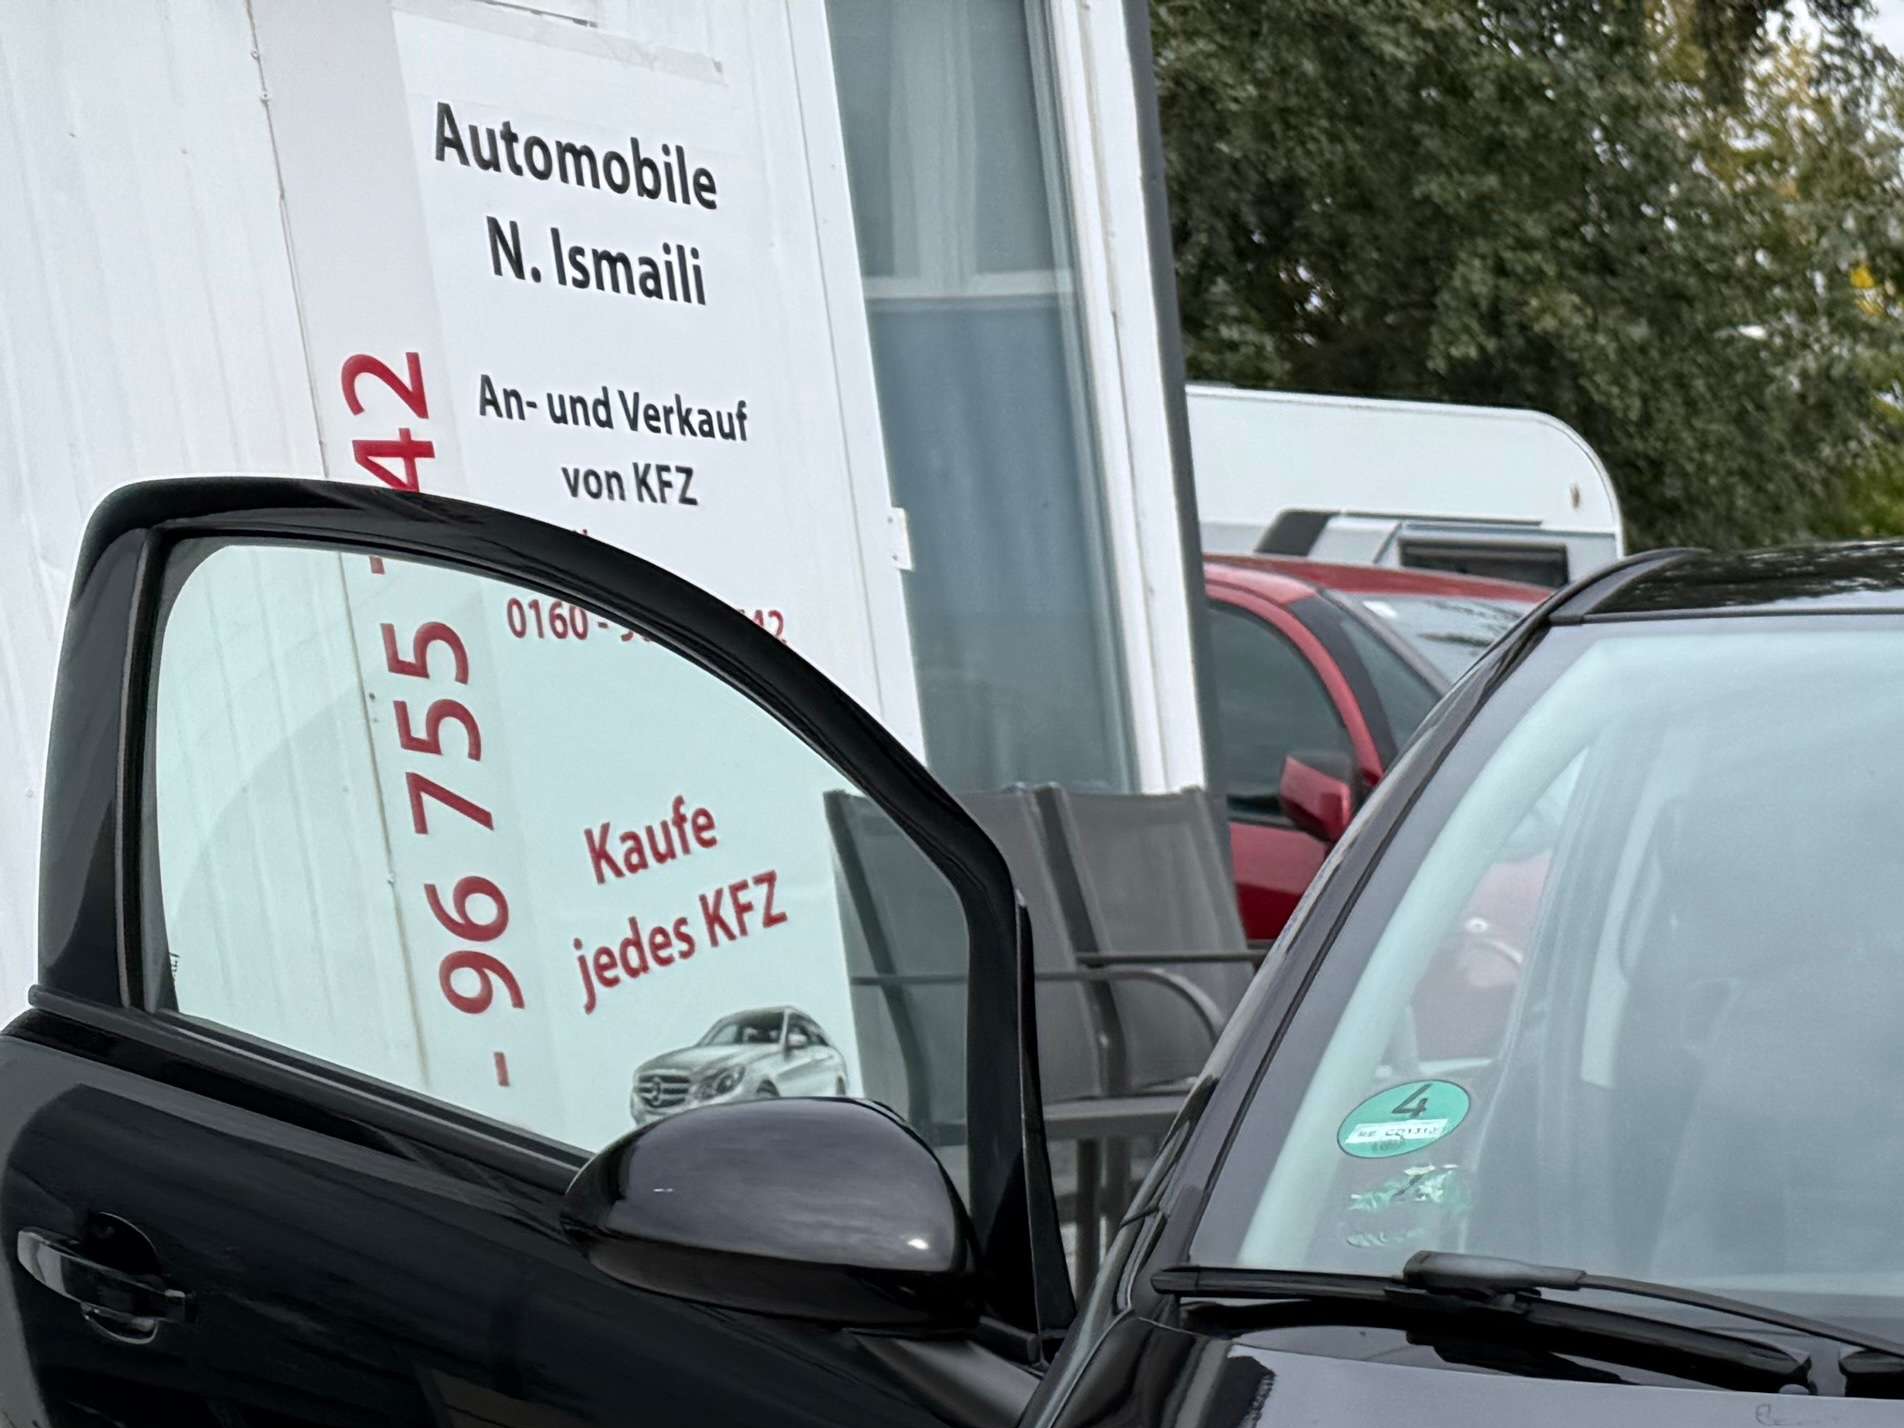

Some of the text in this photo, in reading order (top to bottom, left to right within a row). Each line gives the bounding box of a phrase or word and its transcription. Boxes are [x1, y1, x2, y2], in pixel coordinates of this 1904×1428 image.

[434, 100, 720, 211] Automobile
[486, 215, 707, 307] N. Ismaili
[479, 374, 748, 443] An- und Verkauf
[561, 462, 699, 507] von KFZ
[507, 597, 589, 641] 0160
[382, 620, 495, 835] 755
[585, 796, 719, 884] Kaufe
[425, 876, 526, 1016] 96
[572, 871, 788, 1015] jedes KFZ
[1391, 1083, 1433, 1119] 4
